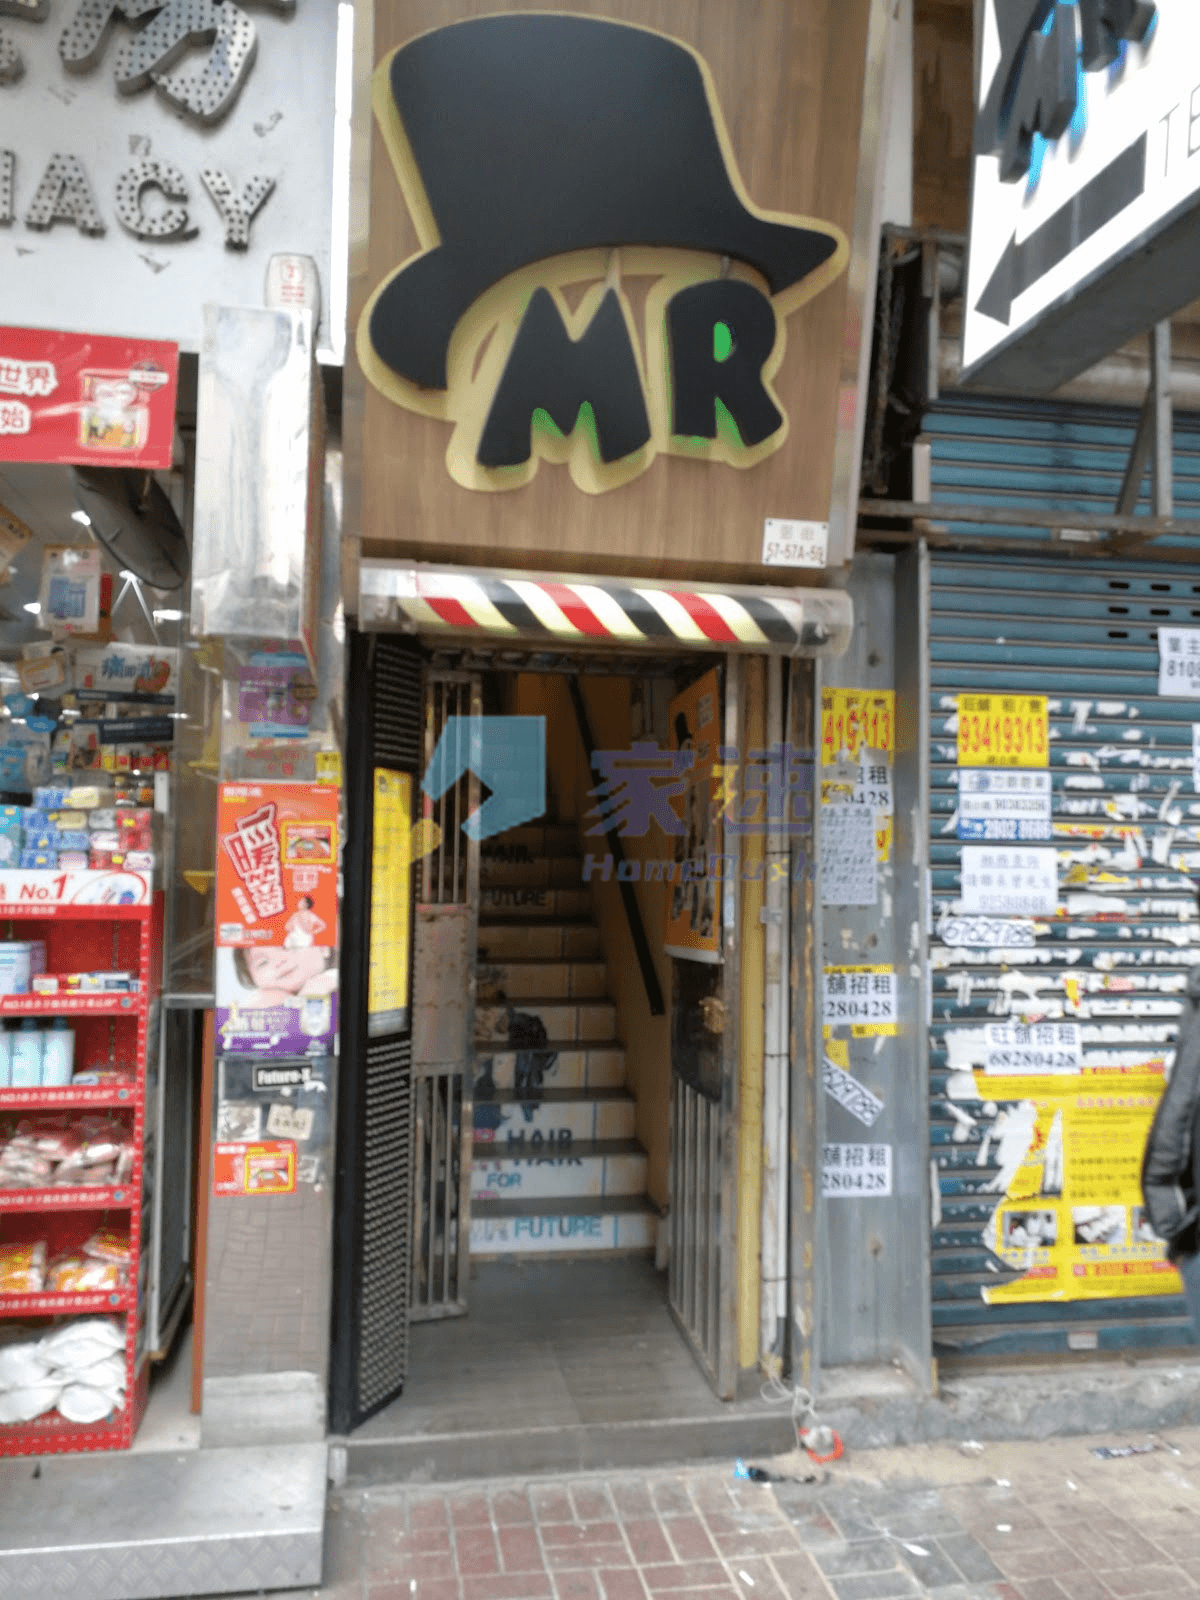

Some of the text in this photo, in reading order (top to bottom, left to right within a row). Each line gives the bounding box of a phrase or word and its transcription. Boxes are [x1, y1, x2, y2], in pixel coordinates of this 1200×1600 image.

[0, 150, 278, 253] ACY
[476, 278, 784, 468] MR
[960, 715, 1046, 753] 93419313
[989, 1050, 1077, 1067] 68280428
[486, 1172, 522, 1188] FOR
[514, 1215, 603, 1239] FUTURE
